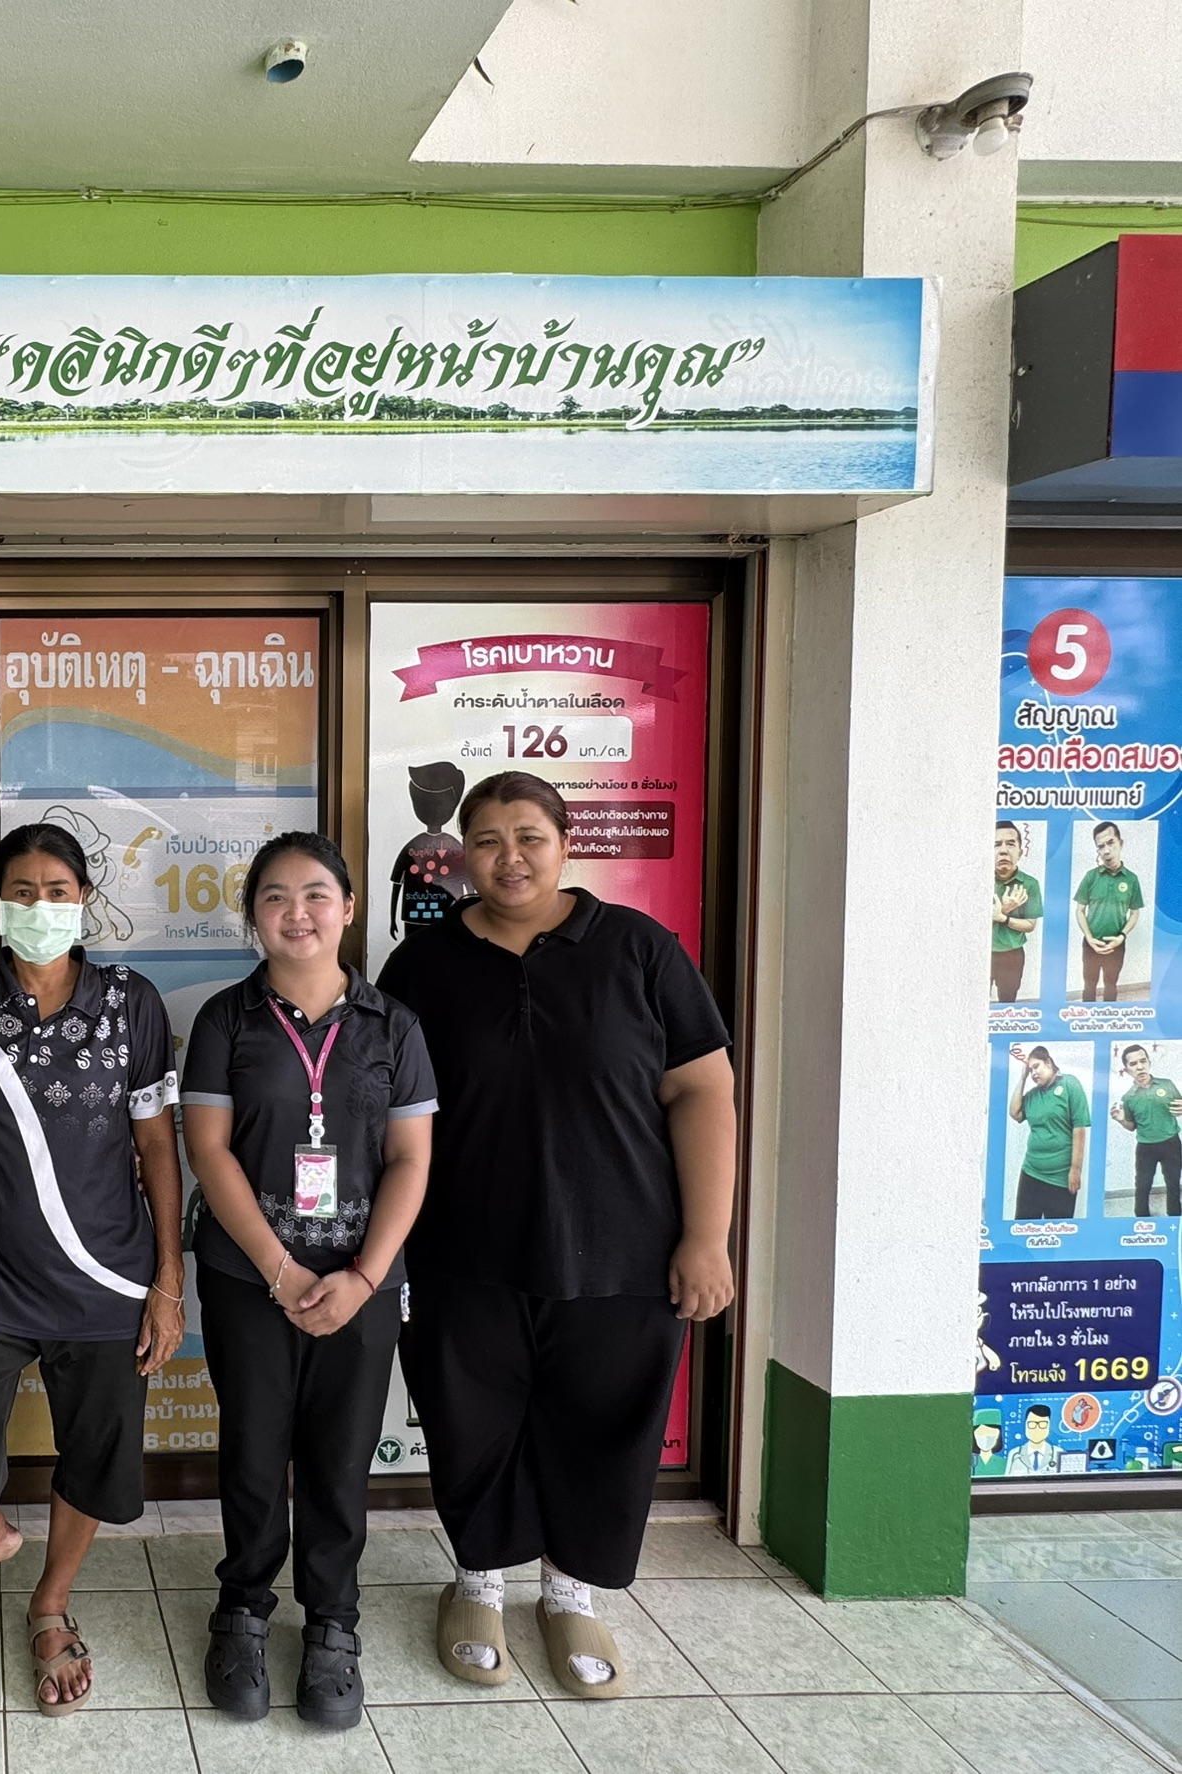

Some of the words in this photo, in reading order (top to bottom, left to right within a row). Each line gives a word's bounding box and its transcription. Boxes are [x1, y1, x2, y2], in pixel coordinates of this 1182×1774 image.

[461, 641, 615, 669] โรคเบาหวาน
[1050, 624, 1089, 681] 5
[6, 631, 147, 705] อุบัติเหตุ
[194, 632, 315, 705] ฉุกเฉิน
[453, 688, 625, 709] ค่าระดับน้ำตาลในเลือด
[1017, 701, 1115, 732] สัญญาณ
[460, 741, 492, 757] ตั้งแต่
[503, 725, 568, 758] 126
[550, 778, 628, 790] าหารอย่างน้อย
[631, 781, 639, 790] 8
[566, 809, 668, 820] วามผิดปกติของร่างกาย
[570, 825, 669, 839] ร์โมนอินซูลินไม่เพียงพอ
[166, 835, 267, 860] เจ็บป่วยฉุกเ
[570, 842, 621, 856] ลในเลือดสูง
[155, 863, 248, 914] 166
[1093, 1279, 1099, 1291] 1
[1104, 1275, 1136, 1290] อย่าง
[1009, 1301, 1133, 1320] ให้รีบไปโรงพยาบาล
[1008, 1329, 1053, 1347] ภายใน
[1057, 1334, 1066, 1346] 3
[1070, 1327, 1109, 1346] ชั่วโมง
[1009, 1362, 1066, 1383] โทรแจ้ง
[1075, 1357, 1149, 1381] 1669
[144, 1431, 217, 1449] 6-030
